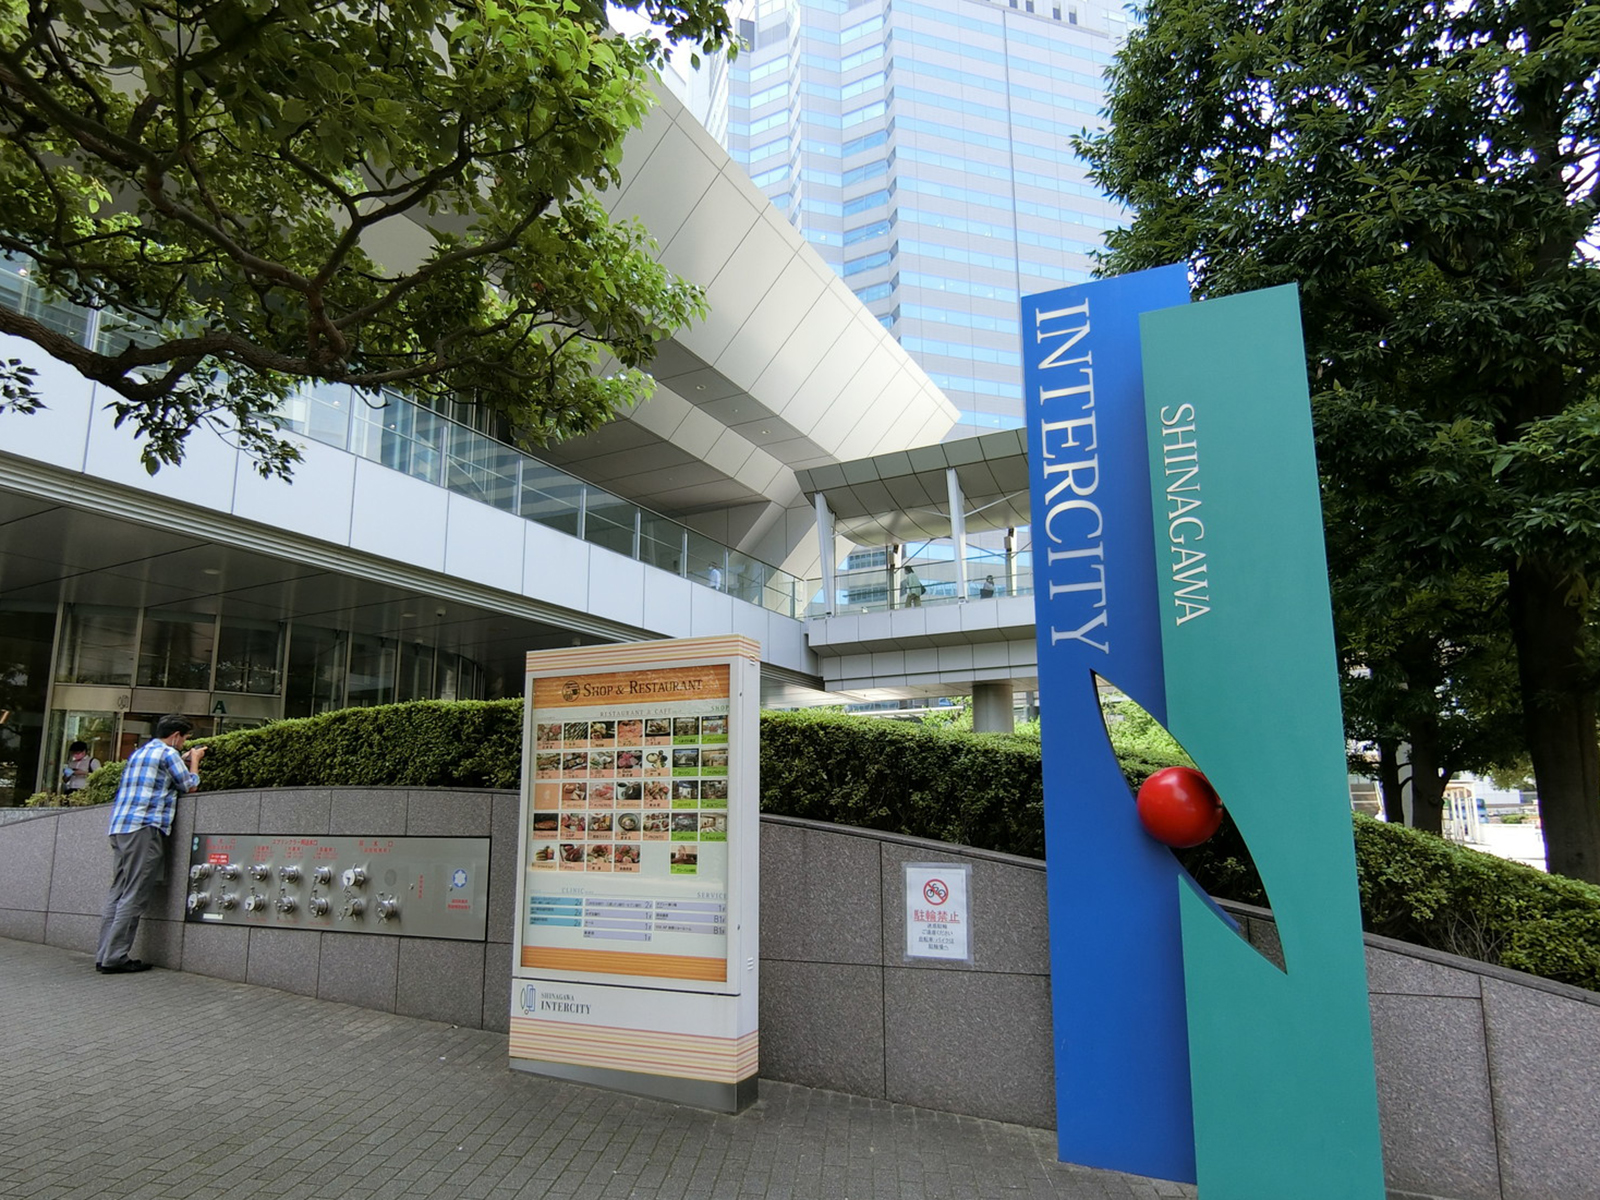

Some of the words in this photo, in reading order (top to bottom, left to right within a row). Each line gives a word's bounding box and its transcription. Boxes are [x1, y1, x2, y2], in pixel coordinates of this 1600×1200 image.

[1035, 297, 1110, 655] INTERCITY
[1160, 402, 1211, 627] SHINAGAWA
[616, 686, 625, 695] &
[212, 700, 227, 714] A
[600, 709, 644, 717] RESTAURANT
[561, 887, 585, 895] CLINIC
[914, 909, 960, 923] 駐輪禁止
[541, 992, 575, 1001] SHINAGAWA
[541, 1000, 592, 1014] INTERCITY
